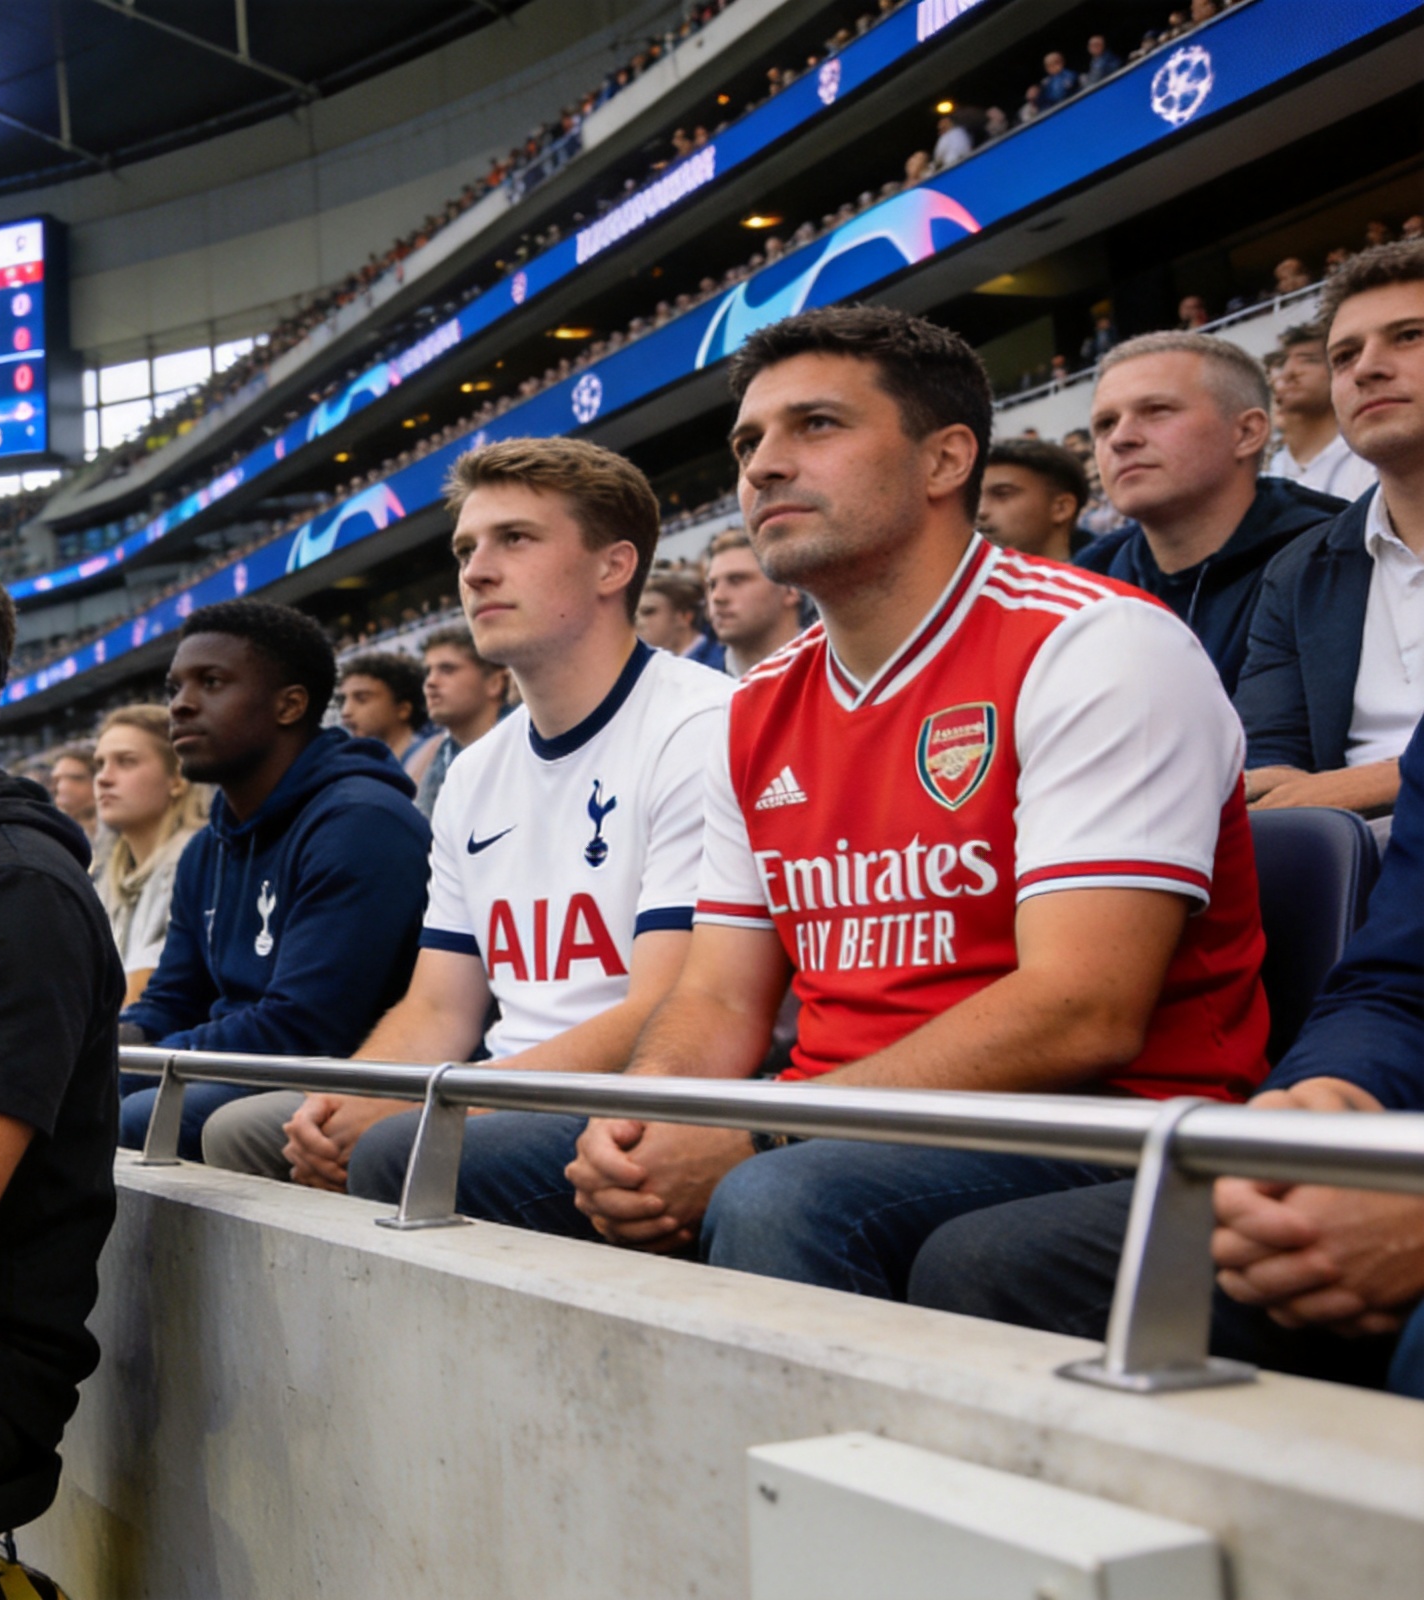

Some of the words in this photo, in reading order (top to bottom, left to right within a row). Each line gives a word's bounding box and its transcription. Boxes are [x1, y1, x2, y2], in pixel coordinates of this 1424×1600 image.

[753, 833, 998, 914] Emirates
[488, 892, 629, 981] AIA
[838, 910, 956, 970] BETTER
